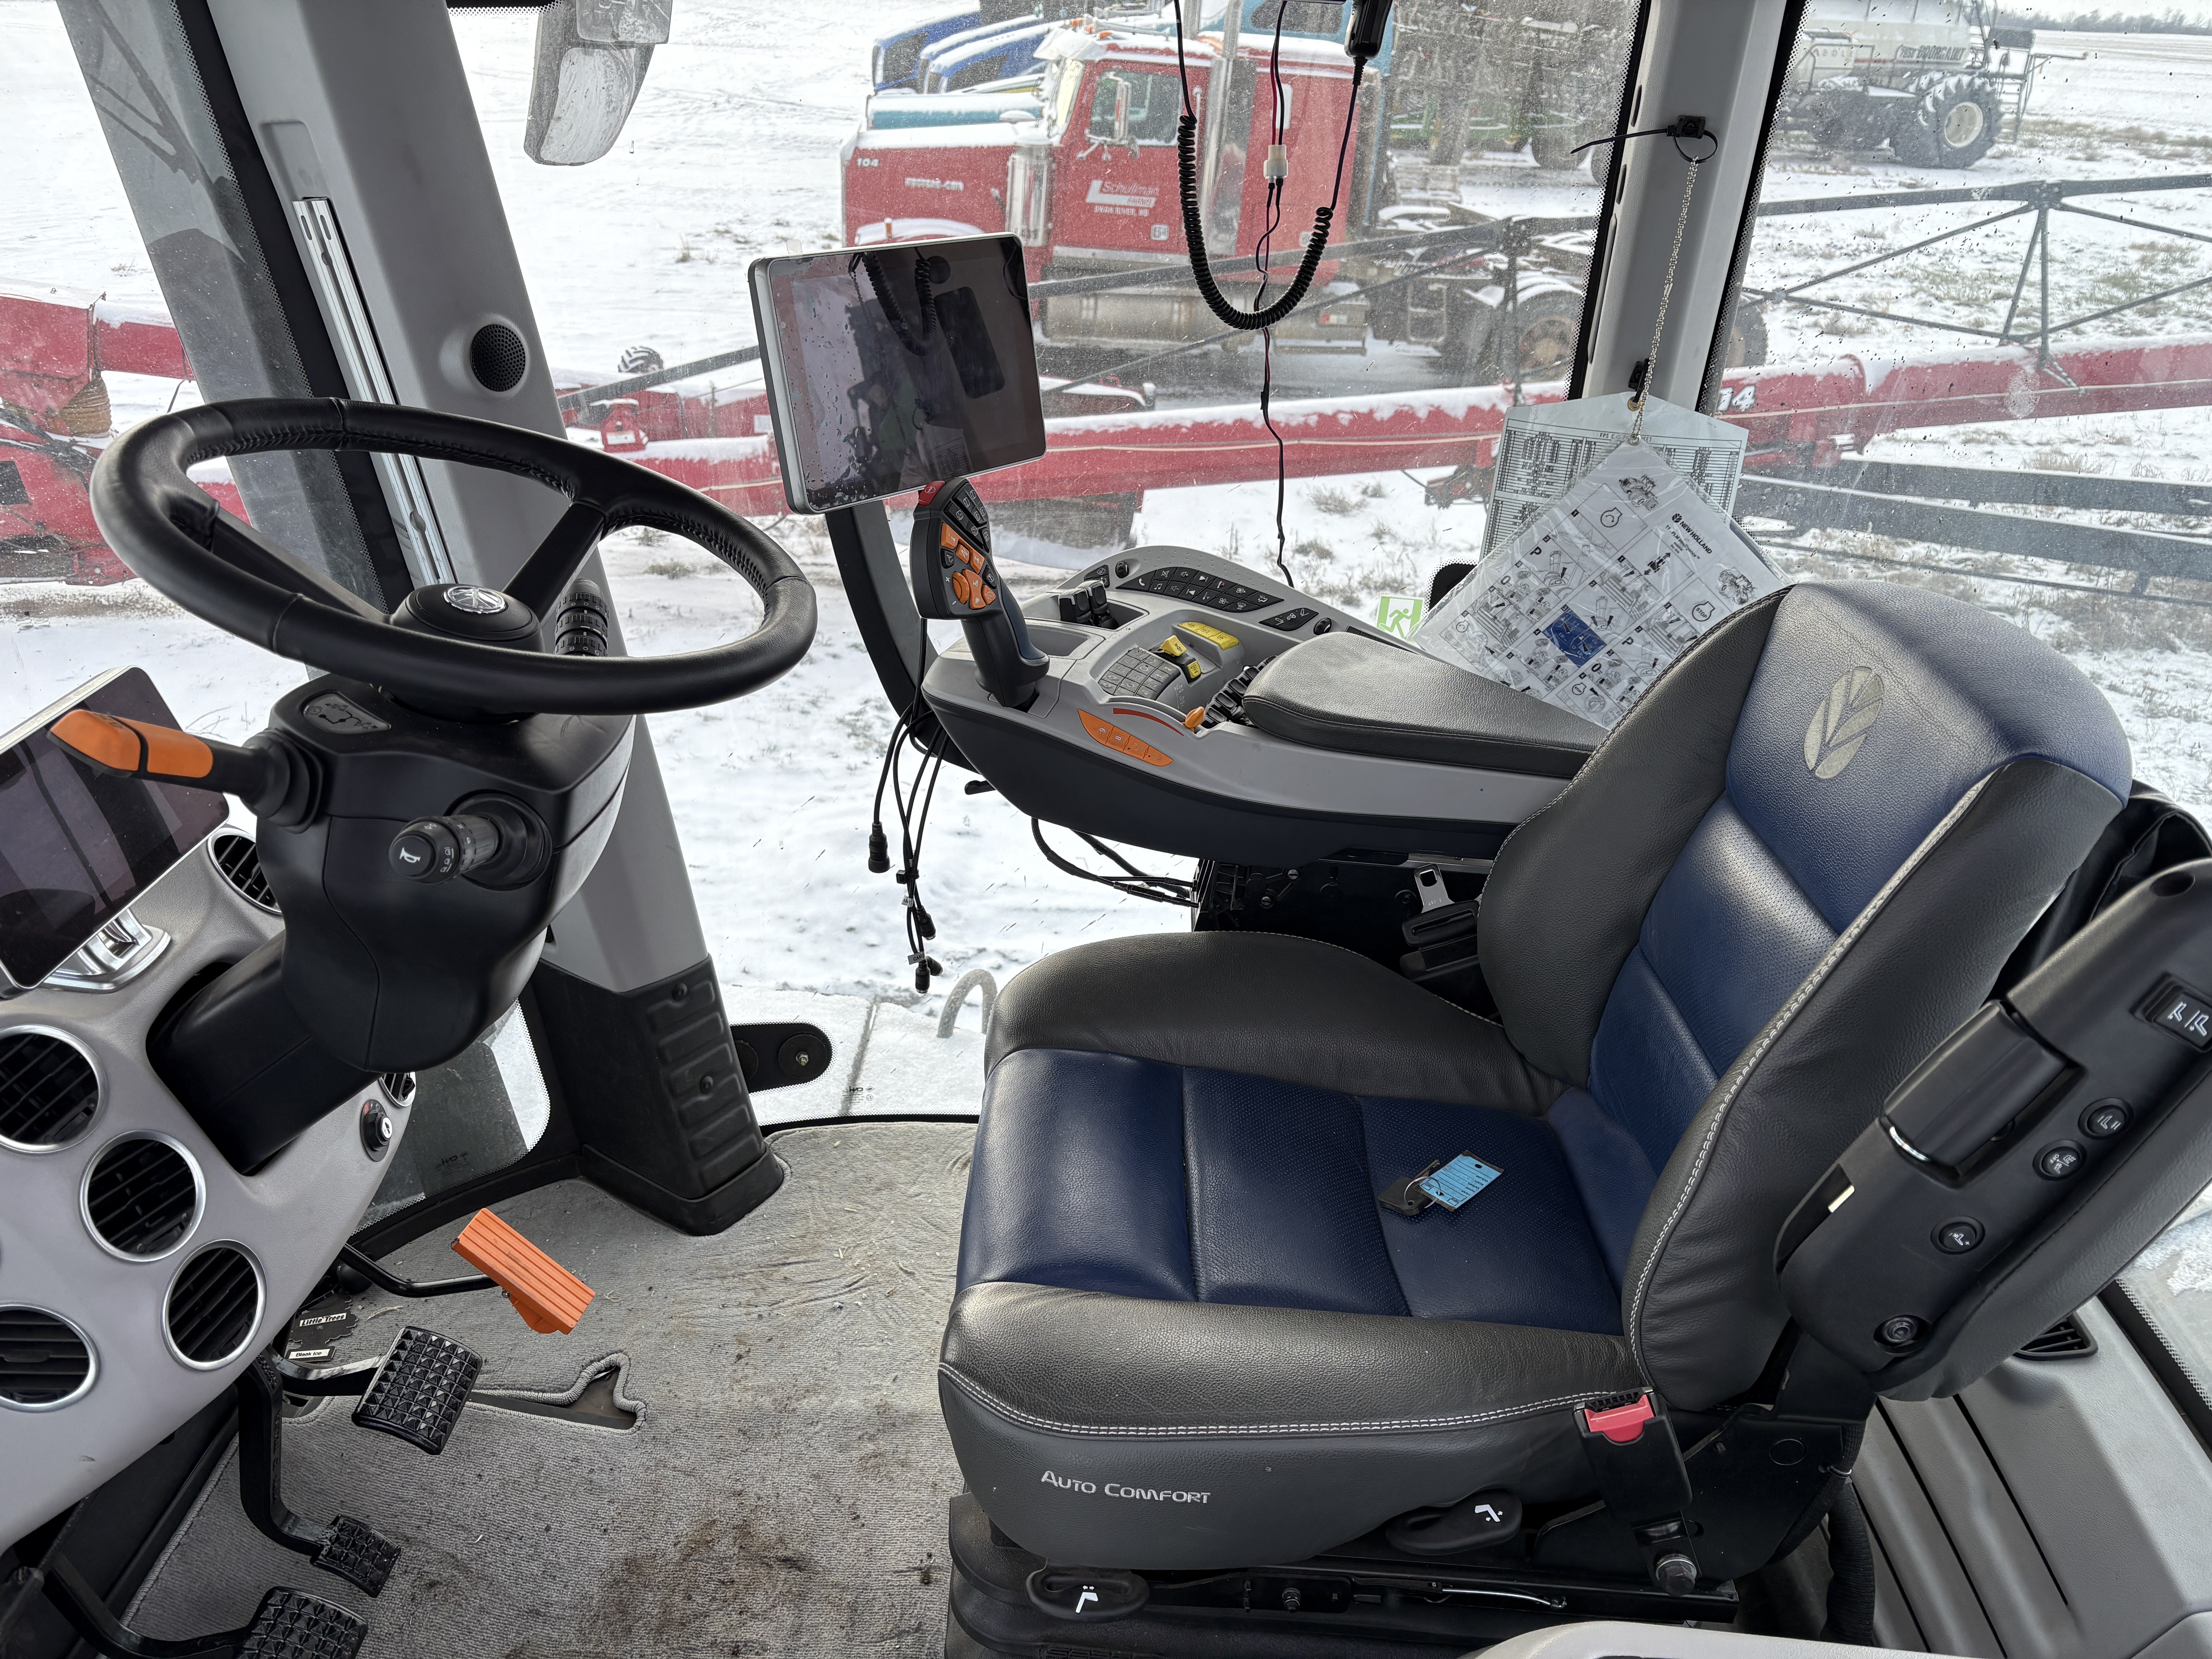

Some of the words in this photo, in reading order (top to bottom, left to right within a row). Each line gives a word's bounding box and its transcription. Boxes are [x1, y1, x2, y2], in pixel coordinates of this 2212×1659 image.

[857, 158, 880, 167] 104
[1671, 531, 1680, 539] PLM
[1680, 521, 1693, 533] NEW
[1690, 531, 1712, 554] HOLLAND
[1530, 546, 1542, 556] P
[1696, 607, 1707, 619] STOP
[1621, 636, 1634, 646] P
[2050, 1154, 2059, 1164] OFF
[302, 1318, 322, 1326] Little
